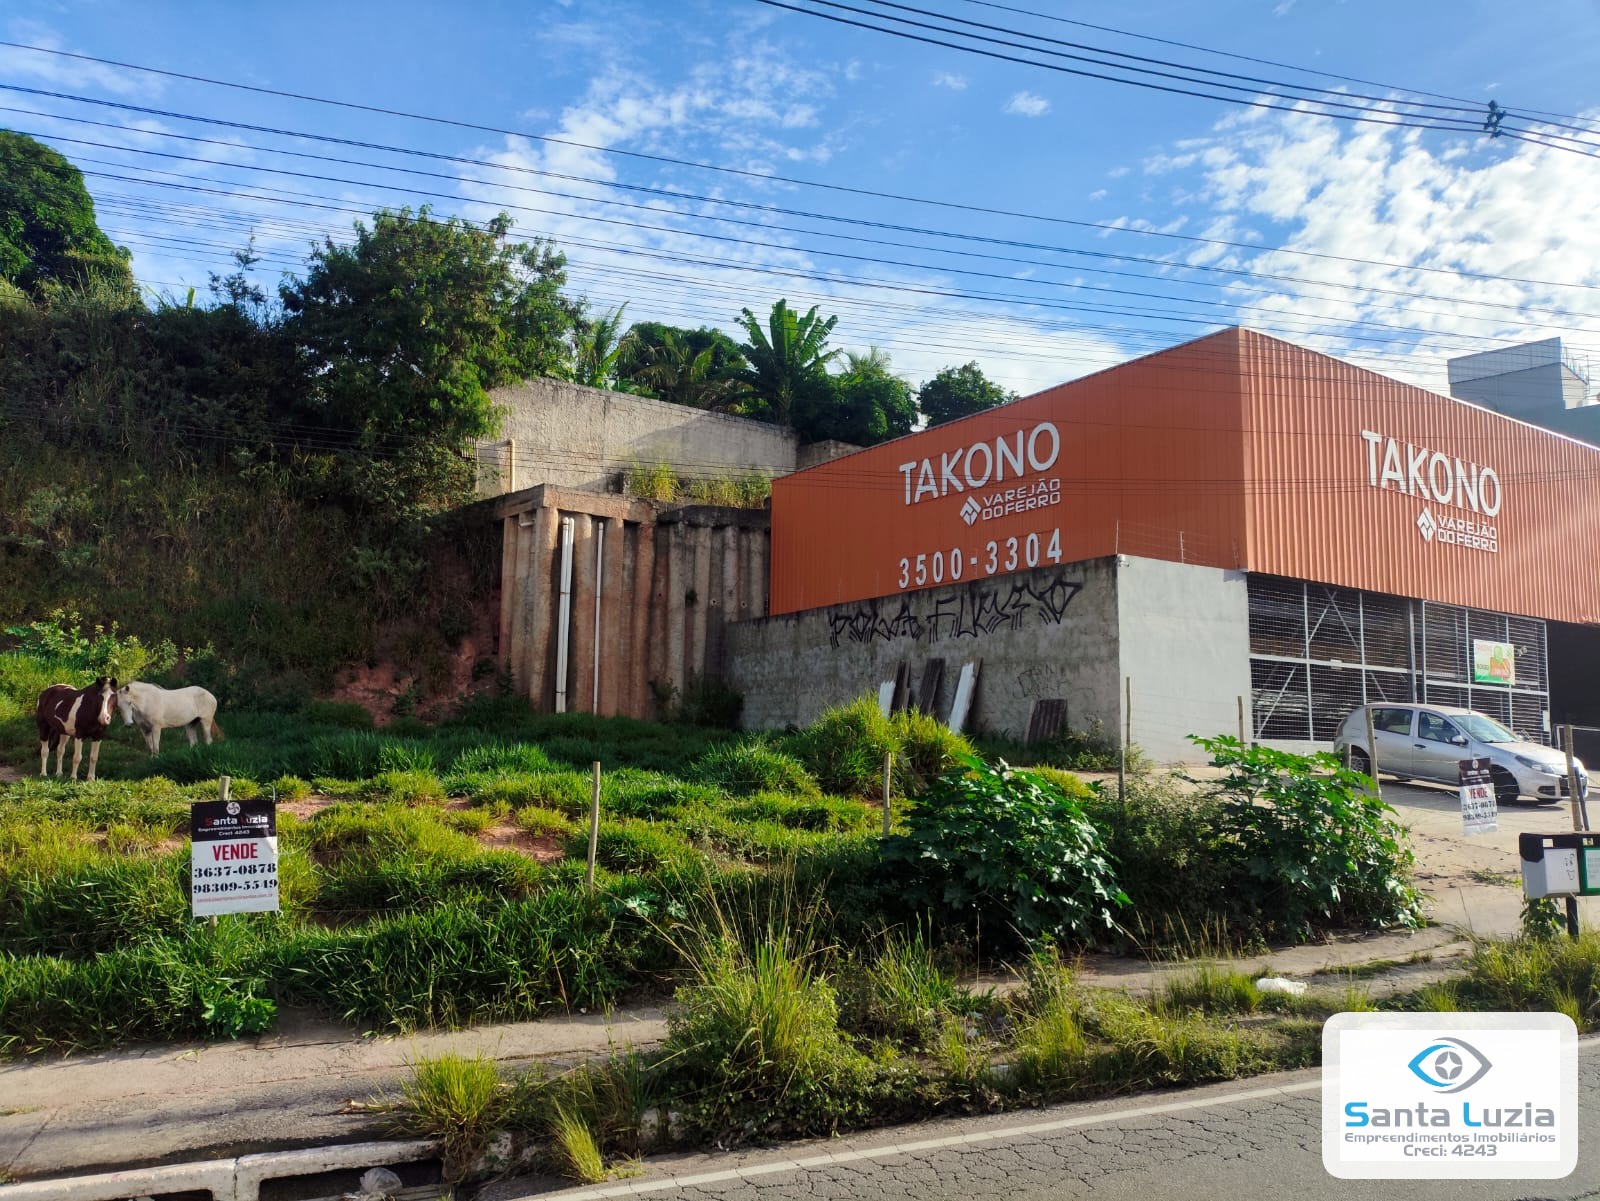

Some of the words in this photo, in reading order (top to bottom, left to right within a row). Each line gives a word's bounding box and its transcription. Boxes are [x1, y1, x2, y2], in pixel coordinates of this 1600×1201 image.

[899, 422, 1061, 505] TAKONO
[1361, 429, 1502, 518] TAKONO
[982, 478, 1061, 507] VAREJÃO
[1437, 514, 1498, 539] VAREJÃO
[898, 528, 1063, 589] 3500-3304
[203, 816, 238, 826] Santa
[212, 842, 258, 861] VENDE
[194, 863, 277, 879] 3637-0878
